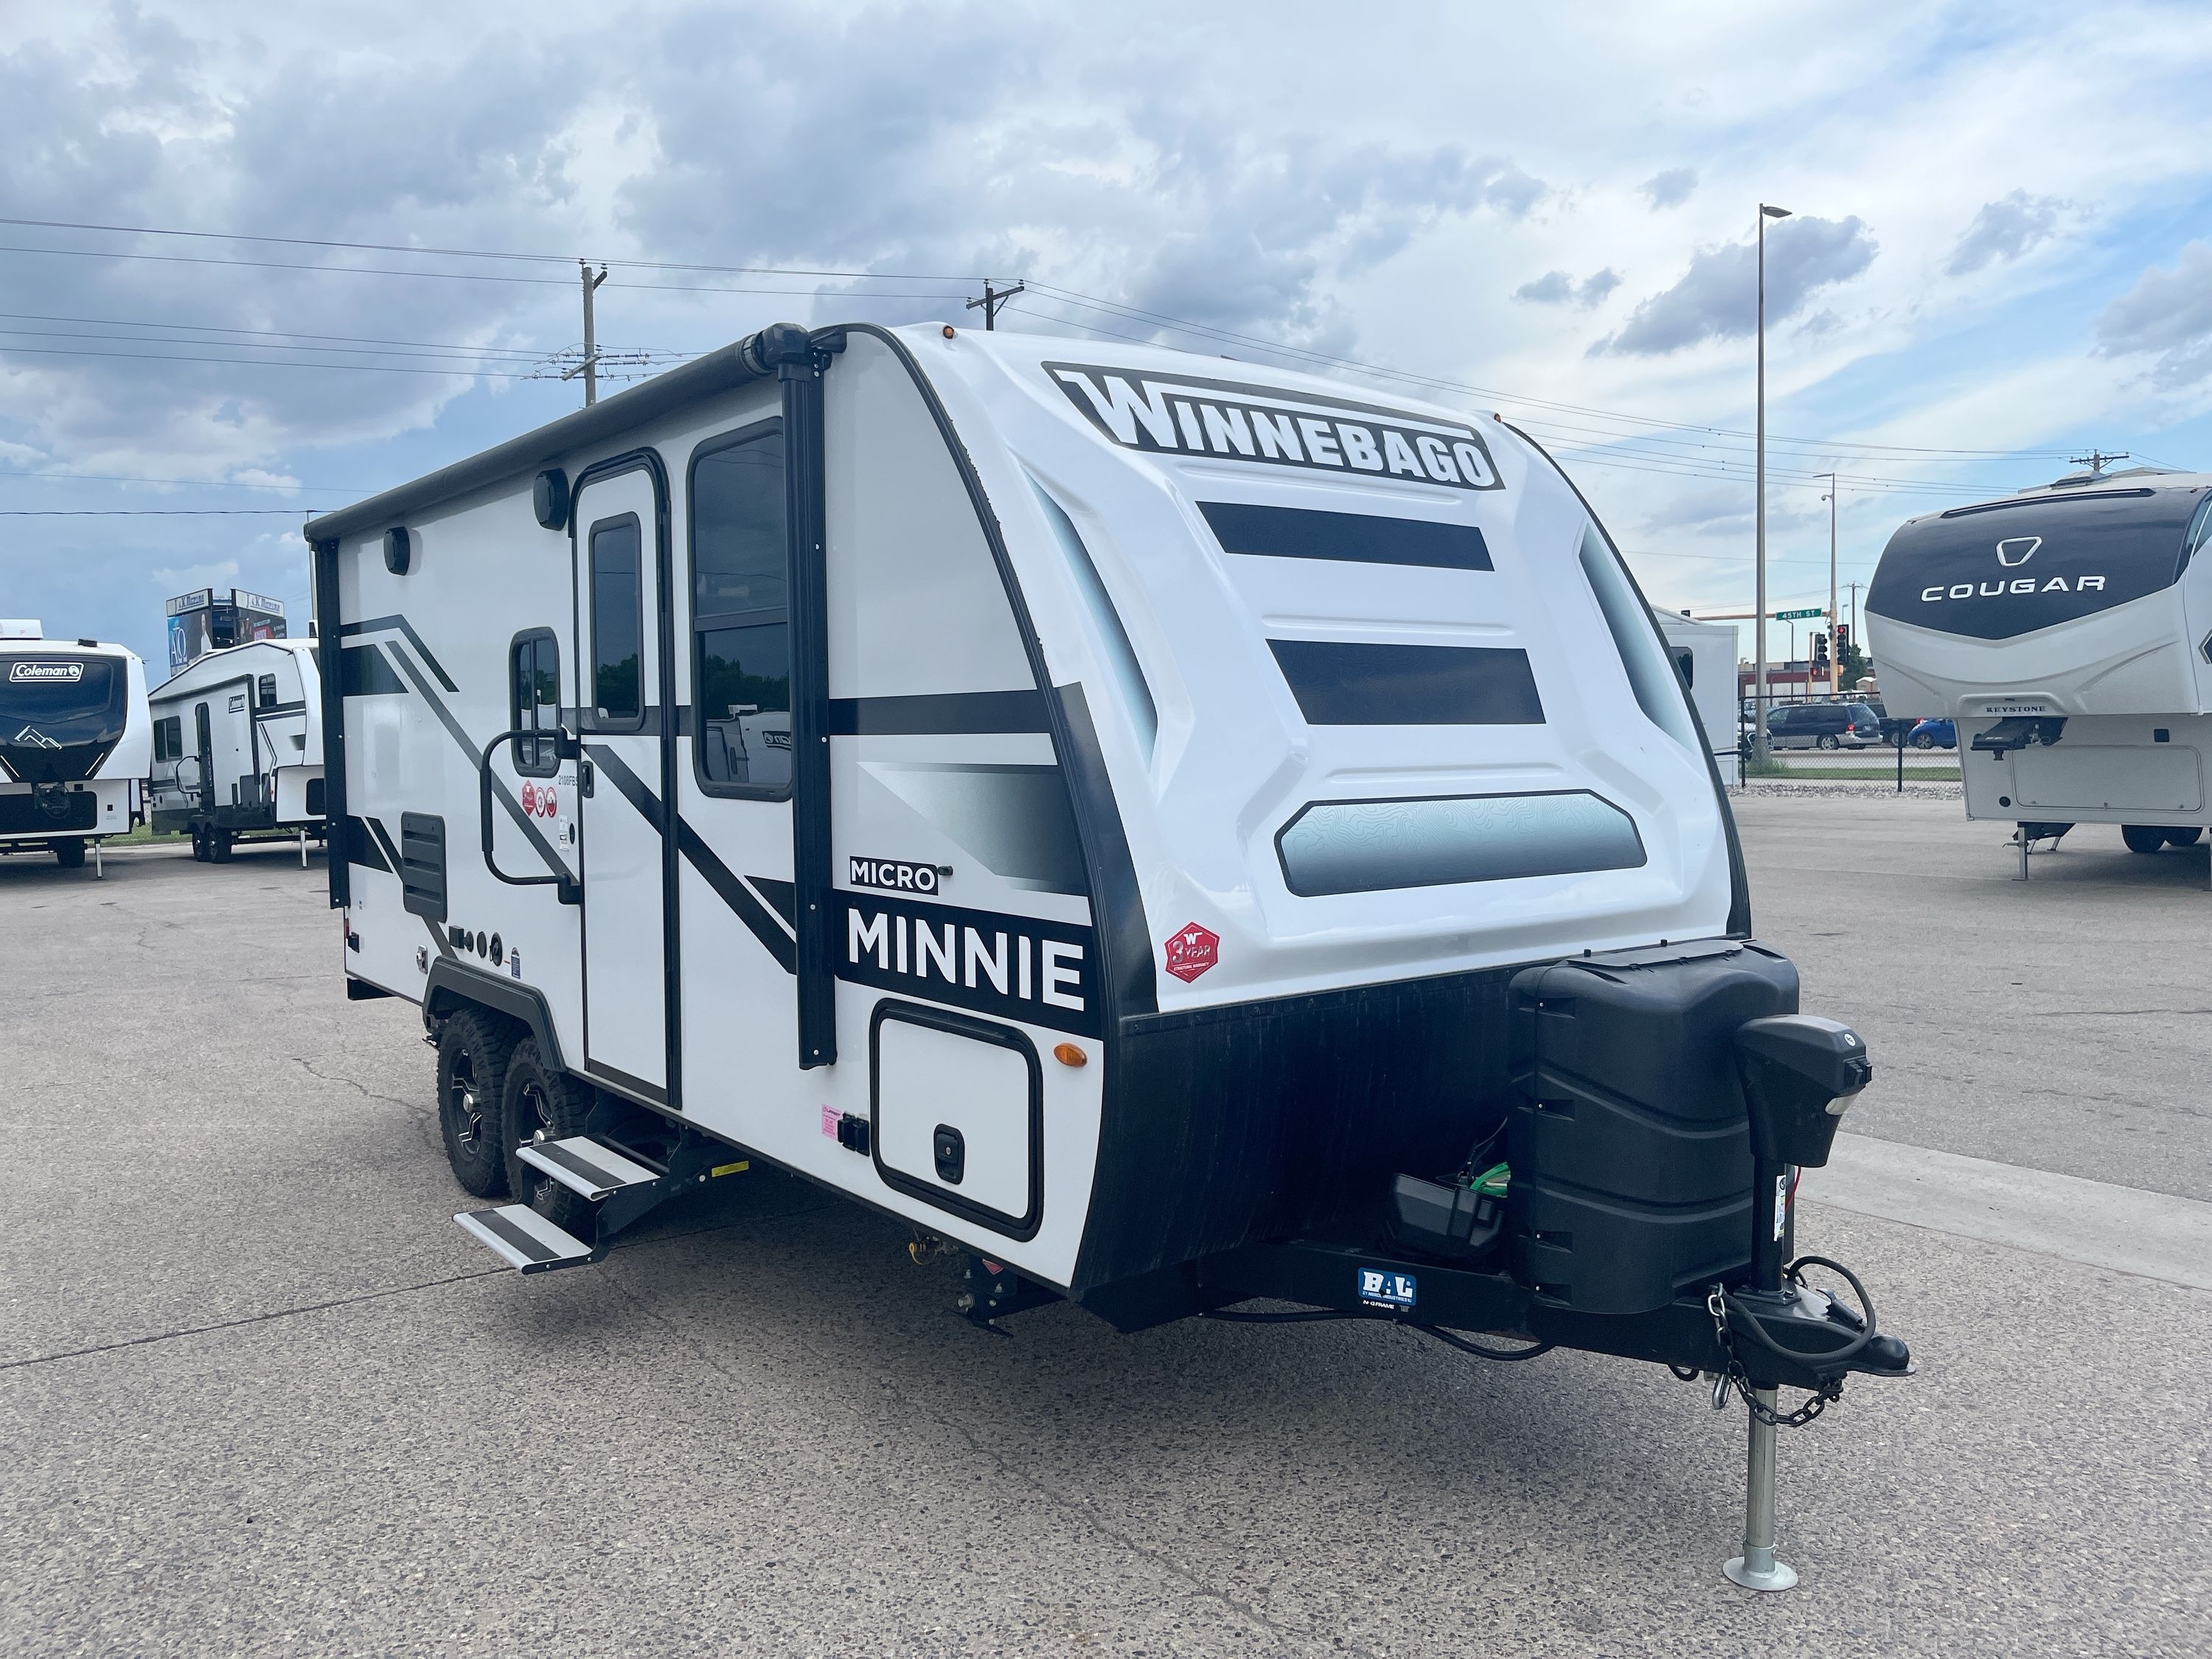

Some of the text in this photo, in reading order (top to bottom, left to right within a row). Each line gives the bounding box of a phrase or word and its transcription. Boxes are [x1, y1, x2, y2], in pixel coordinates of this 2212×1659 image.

[1052, 368, 1496, 487] WINNEBAGO
[1920, 575, 2107, 602] COUGAR
[1782, 611, 1802, 619] 45TH
[15, 664, 68, 677] Coleman
[851, 860, 936, 891] MICRO
[848, 908, 1085, 1012] MINNIE
[1172, 940, 1211, 964] 3 YEAR
